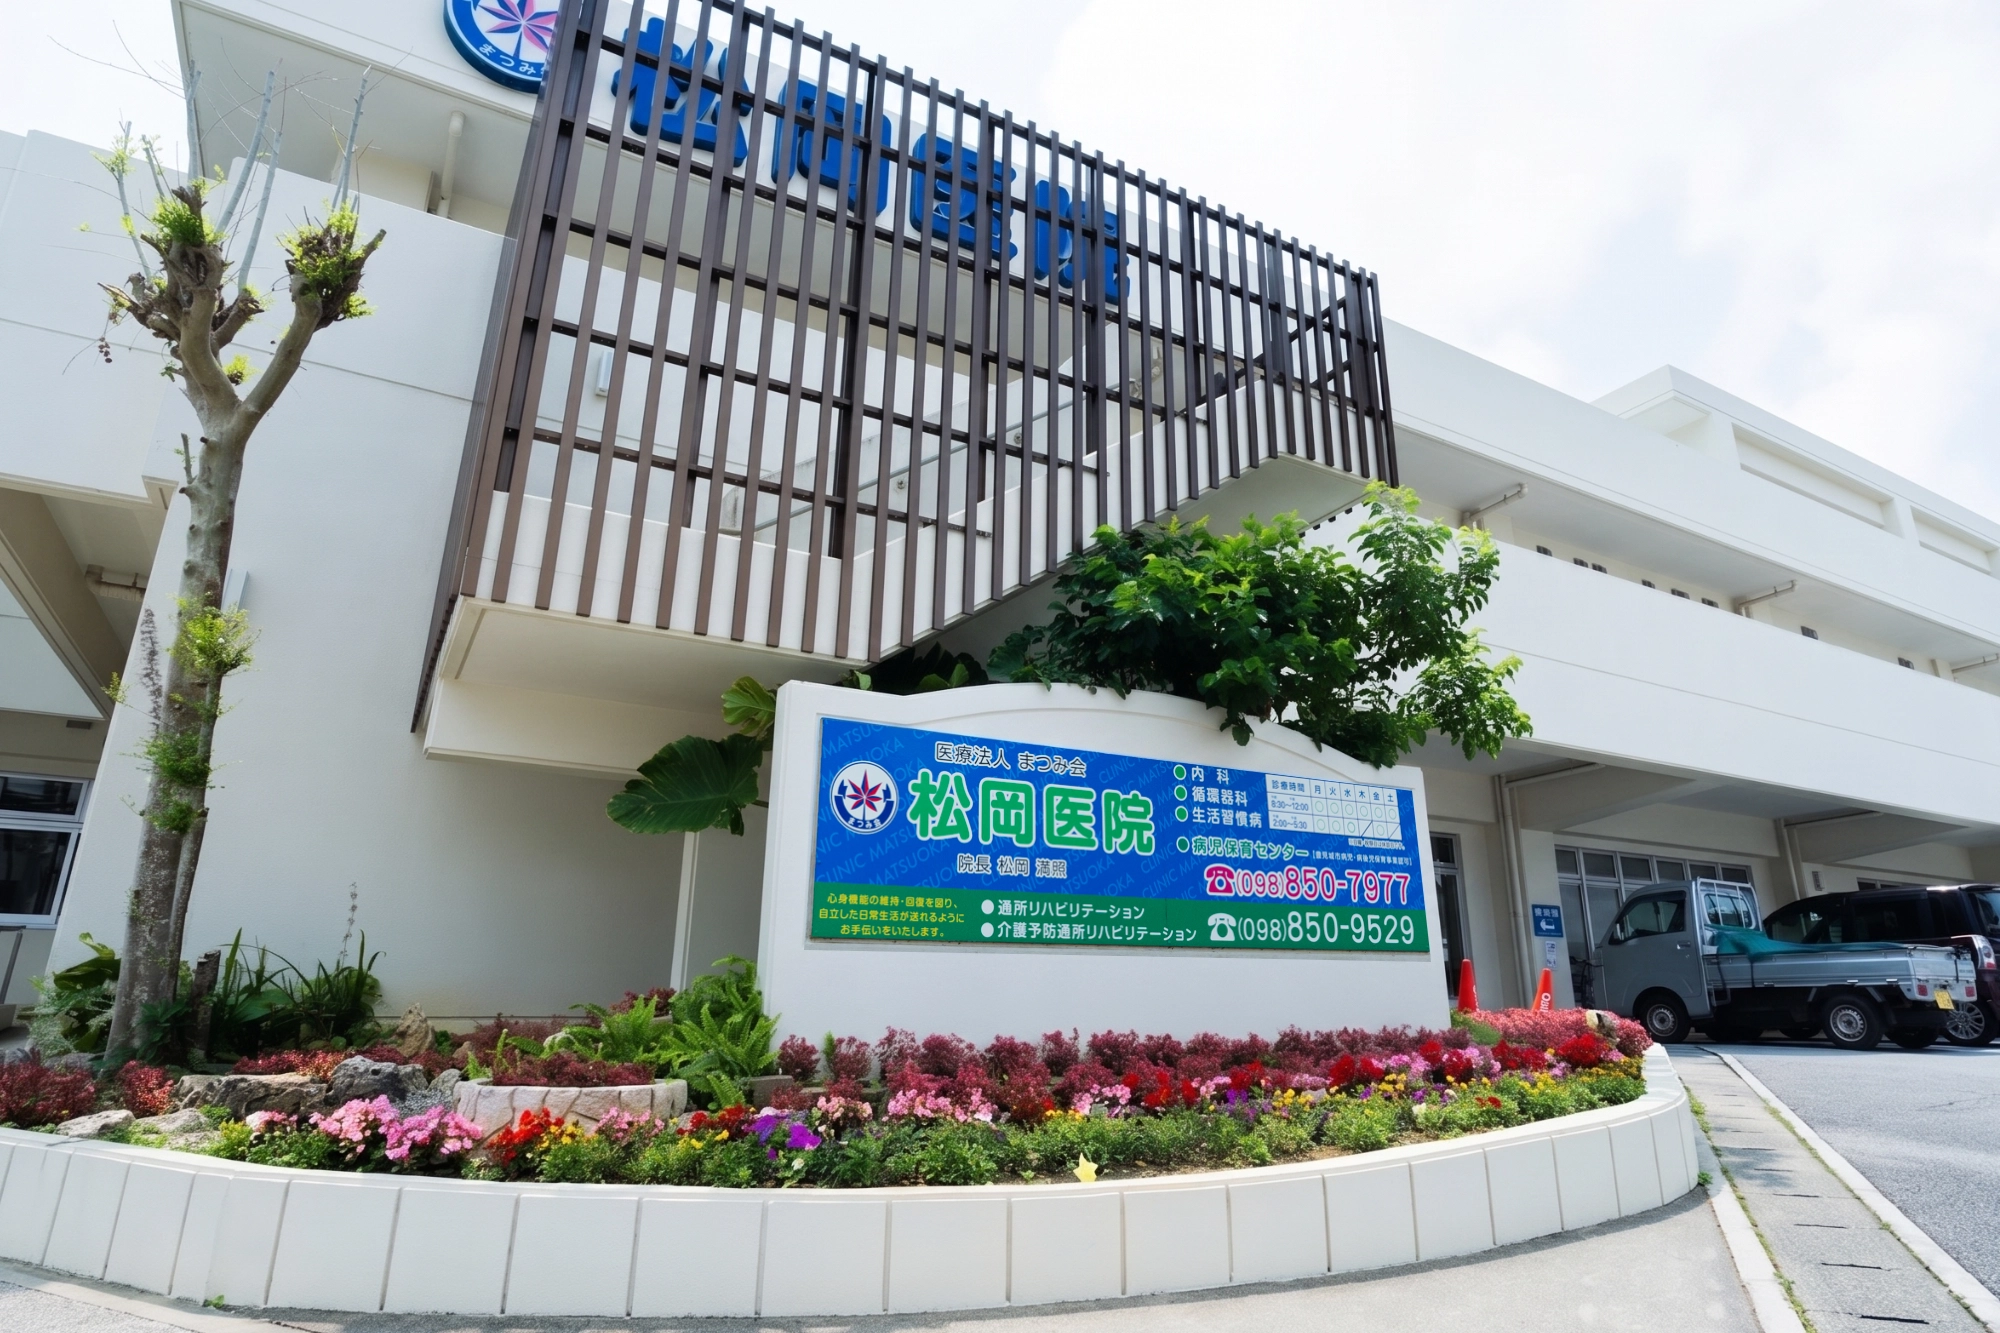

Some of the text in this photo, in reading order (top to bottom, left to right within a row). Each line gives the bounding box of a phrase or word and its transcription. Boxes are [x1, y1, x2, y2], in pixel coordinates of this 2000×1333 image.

[479, 44, 546, 76] まつみ
[936, 742, 1010, 769] 医療法人
[1018, 752, 1086, 777] まつみ会
[1192, 786, 1248, 807] 循環器科
[1271, 780, 1305, 792] 診療時間
[1314, 784, 1322, 795] 月
[1329, 787, 1337, 796] 火
[1343, 788, 1352, 798] 水
[1358, 790, 1366, 799] 木
[1373, 792, 1381, 801] 金
[1387, 793, 1395, 803] 土
[907, 769, 1154, 855] 松岡医院
[1192, 807, 1262, 828] 生活習慣病
[847, 817, 883, 830] まつみ会
[1192, 836, 1309, 861] 病児保育センター
[958, 854, 992, 875] 院長
[998, 856, 1030, 876] 松岡
[1236, 865, 1410, 904] (098)850-7977
[819, 908, 965, 923] 自立した日常生活が送れるように
[998, 900, 1145, 920] 通所リハビリテーション
[840, 925, 944, 937] お手伝いをいたします。
[997, 922, 1197, 942] 介護予防通所リハビリテーション
[1238, 911, 1415, 945] (098)850-9529
